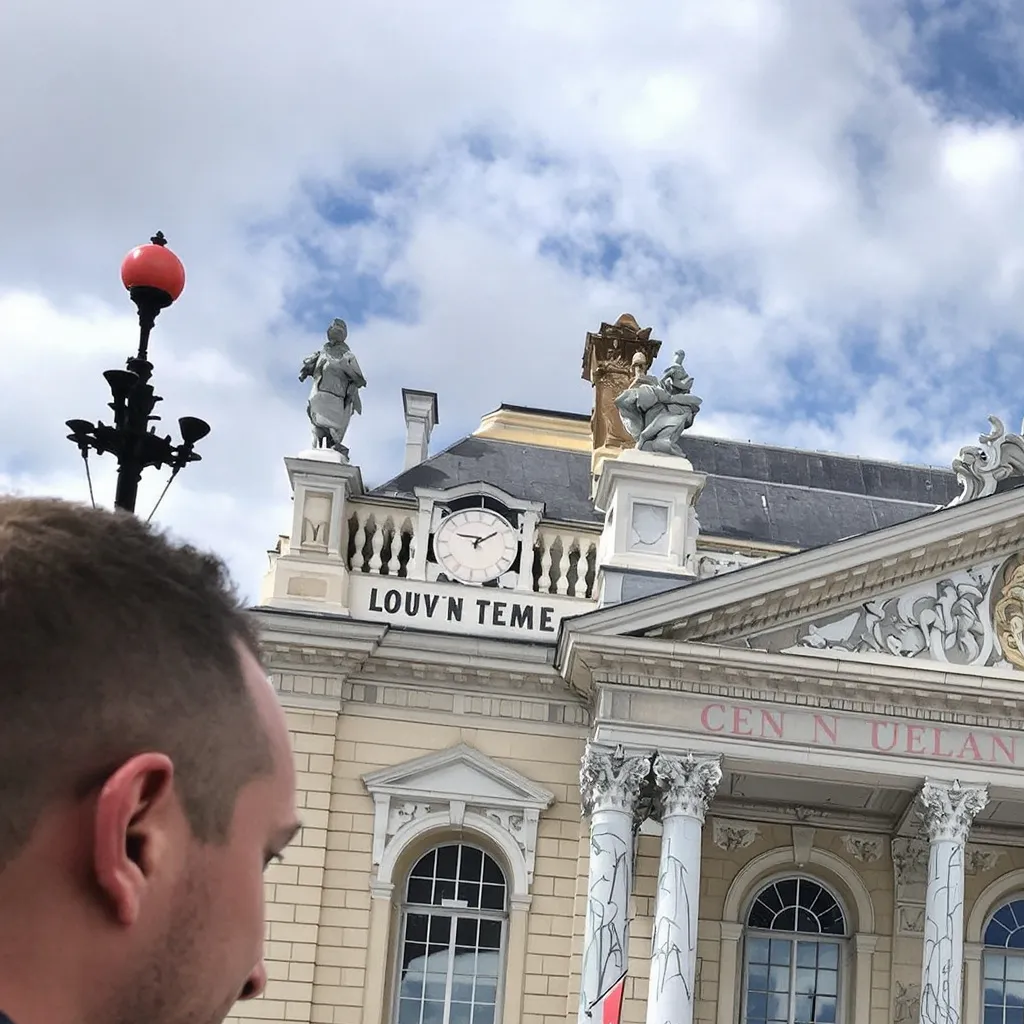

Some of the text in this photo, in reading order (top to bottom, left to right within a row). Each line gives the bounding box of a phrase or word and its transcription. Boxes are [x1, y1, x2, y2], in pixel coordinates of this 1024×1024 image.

[476, 599, 555, 632] TEME
[700, 703, 784, 738] CEN
[813, 714, 842, 745] N
